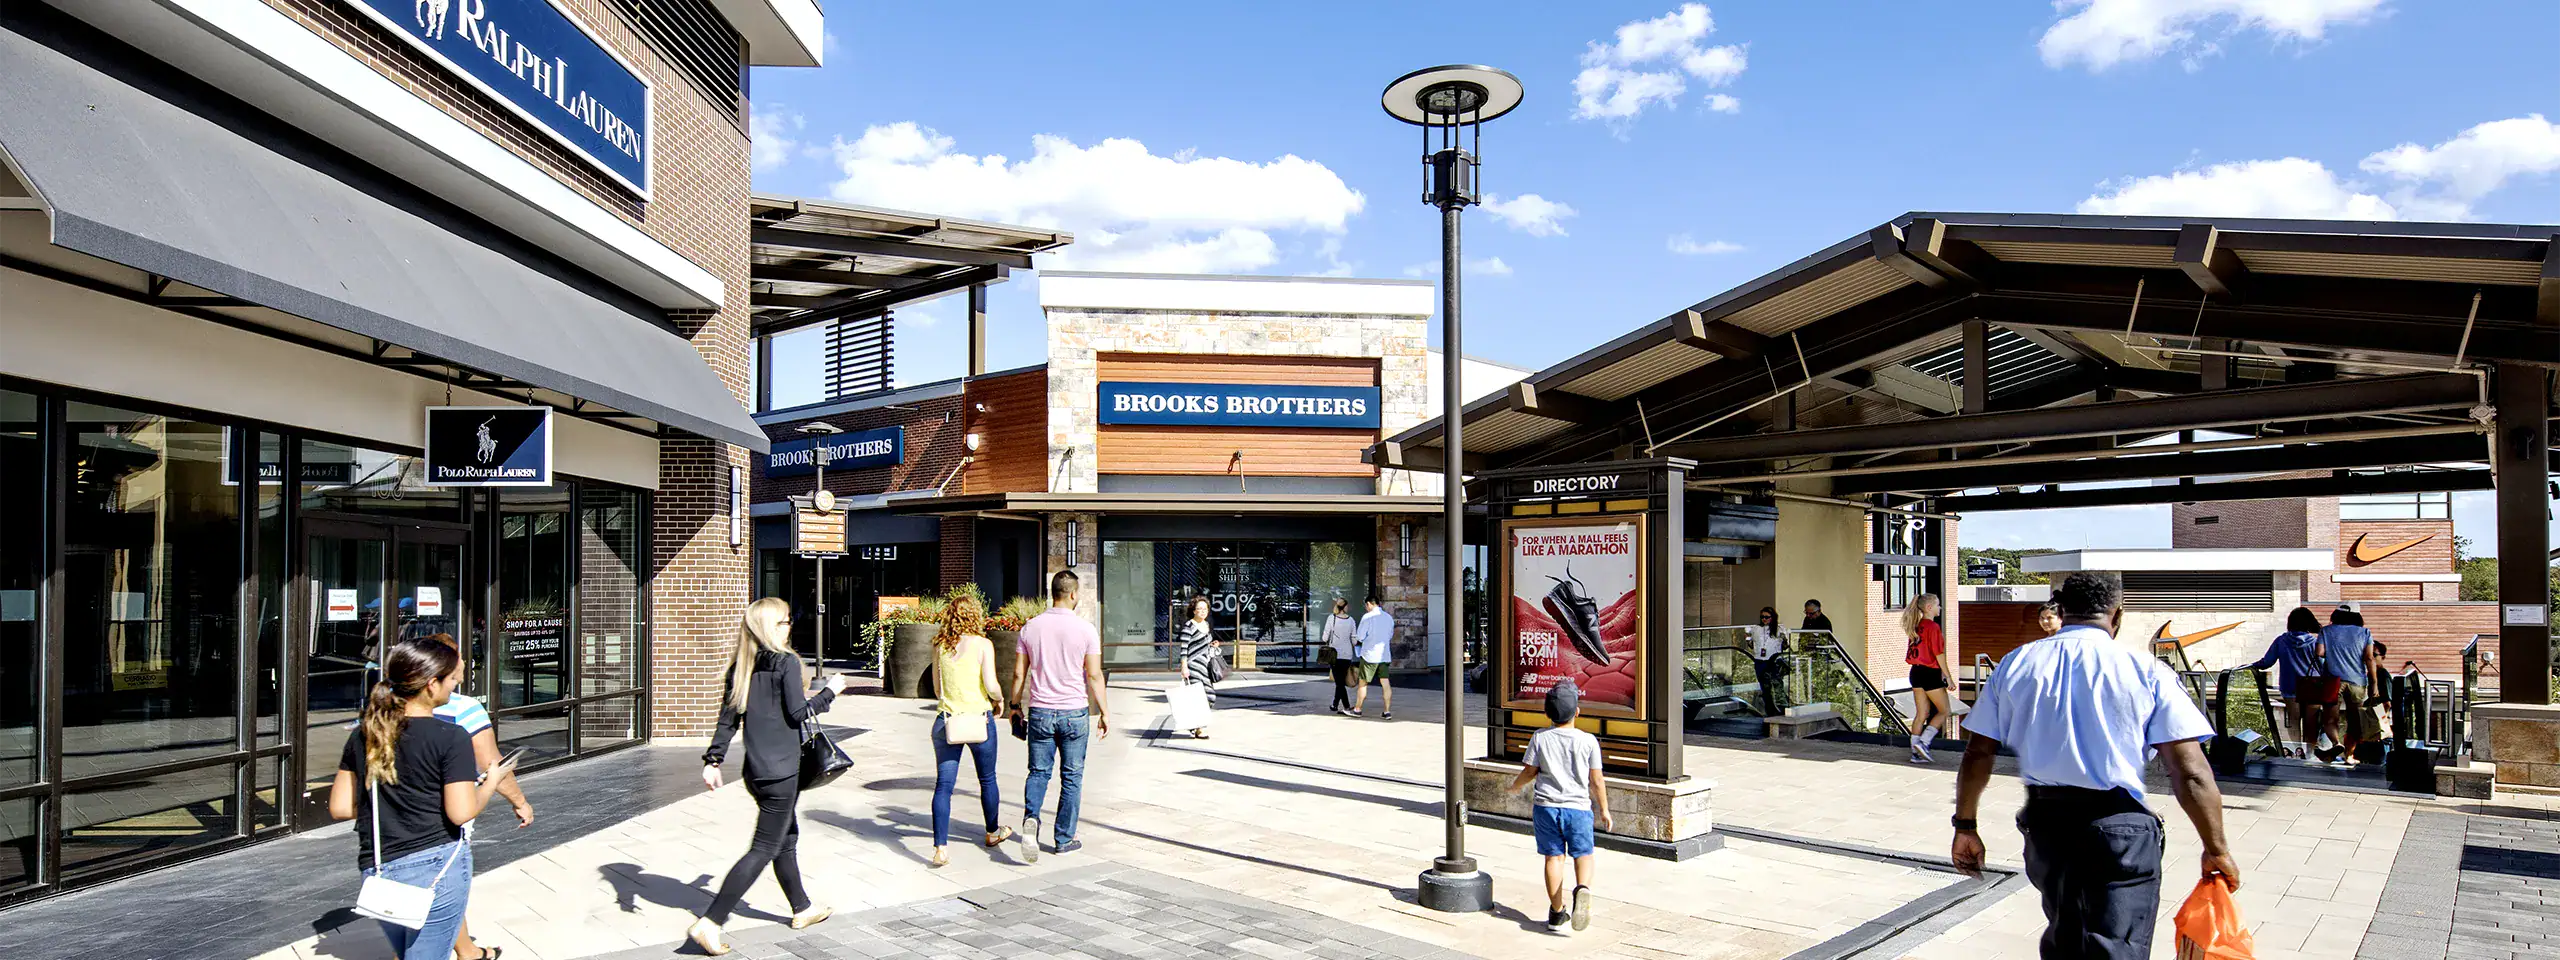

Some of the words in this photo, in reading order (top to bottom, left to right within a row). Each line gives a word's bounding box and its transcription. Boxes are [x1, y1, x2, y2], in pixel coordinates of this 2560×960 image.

[456, 0, 552, 99] RALPH
[555, 57, 642, 163] LAUREN
[1113, 394, 1219, 413] BROOKS
[1226, 396, 1367, 416] BROTHERS
[829, 439, 893, 461] ROTHERS
[438, 465, 465, 478] POLO
[465, 465, 497, 478] RALPH
[497, 465, 537, 478] LAUREN
[1533, 475, 1620, 493] DIRECTORY
[1522, 536, 1539, 545] FOR
[1541, 535, 1567, 545] WHEN
[1569, 535, 1576, 544] A
[1578, 534, 1604, 543] MALL
[1604, 533, 1629, 543] FEELS
[1522, 545, 1544, 556] LIKE
[1547, 545, 1556, 556] A
[1558, 543, 1629, 556] MARATHON
[1211, 594, 1257, 612] 50%
[506, 620, 523, 629] SHOP
[524, 620, 537, 628] FOR
[525, 639, 541, 650] 25%
[1520, 631, 1558, 645] FRESH
[1520, 645, 1558, 659] FOAM
[1520, 658, 1558, 668] ARISHI
